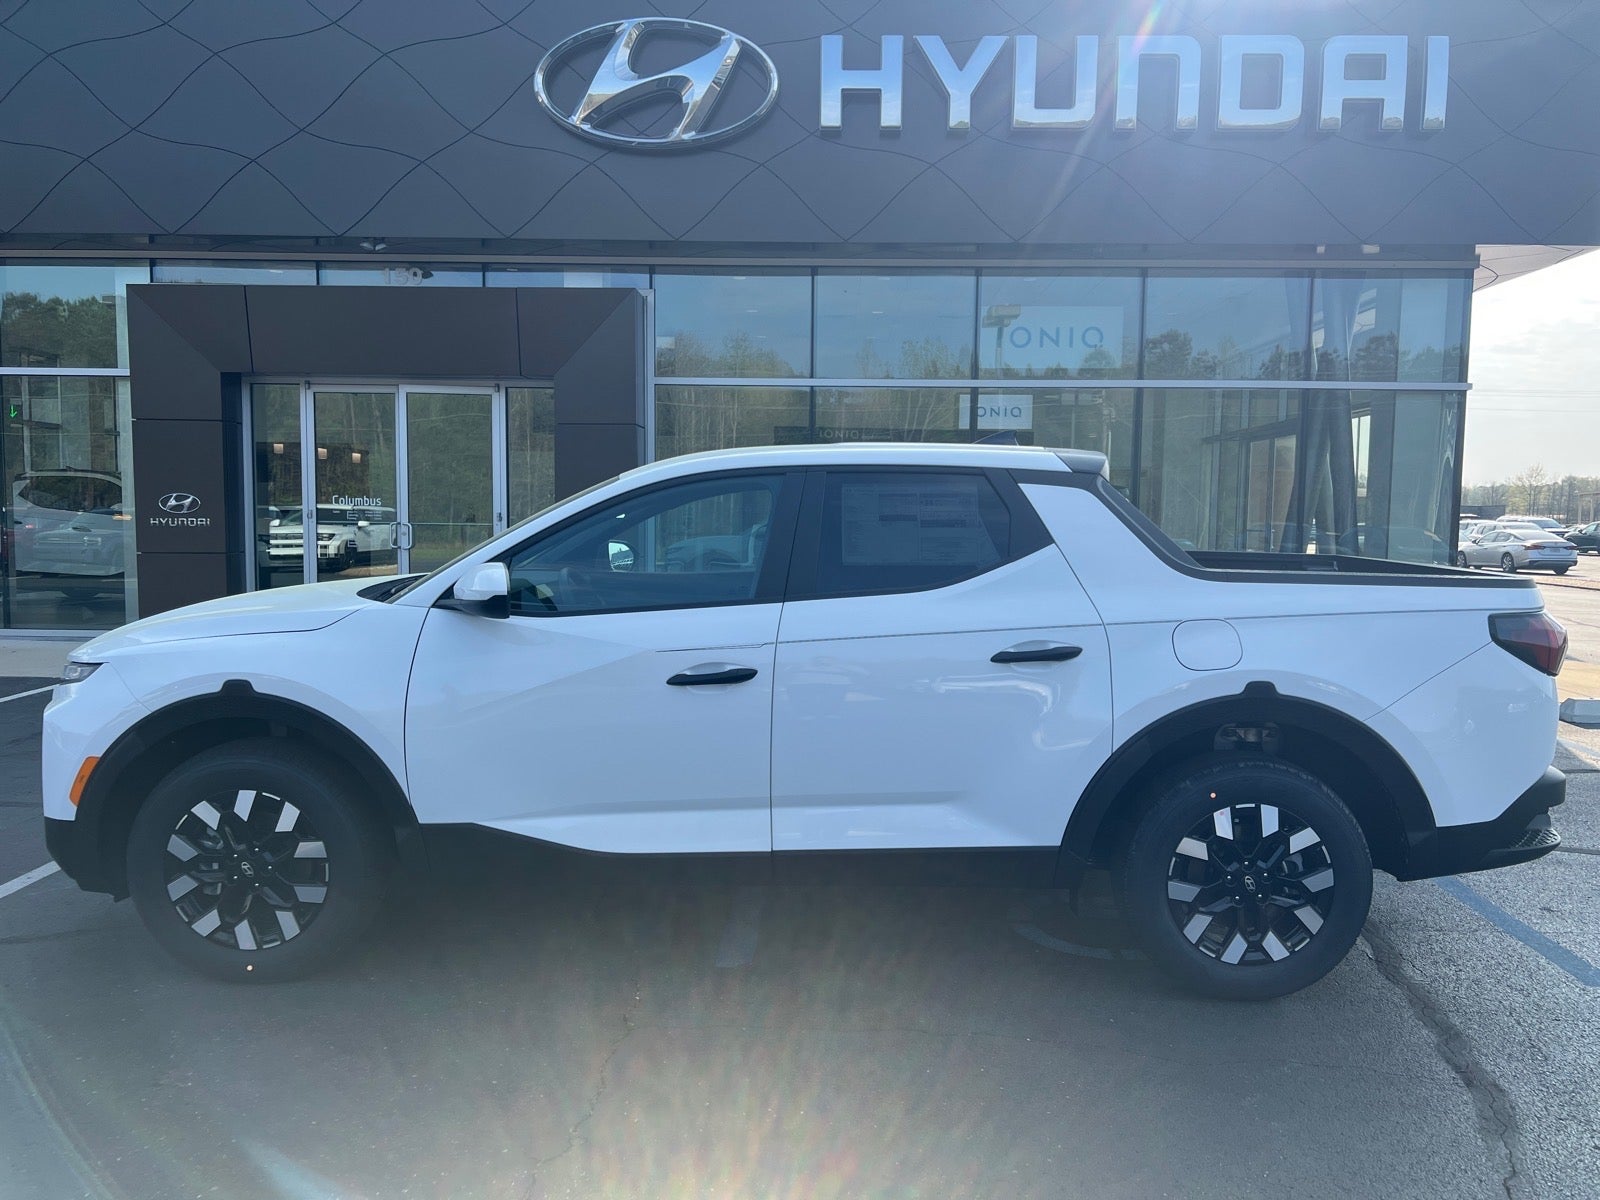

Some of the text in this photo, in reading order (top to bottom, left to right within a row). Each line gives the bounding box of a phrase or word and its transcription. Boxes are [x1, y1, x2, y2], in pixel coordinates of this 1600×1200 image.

[819, 34, 1449, 131] HYUNDAI
[977, 406, 1022, 418] ONIQ
[332, 495, 382, 506] Columbus
[150, 517, 210, 527] HYUNDAI
